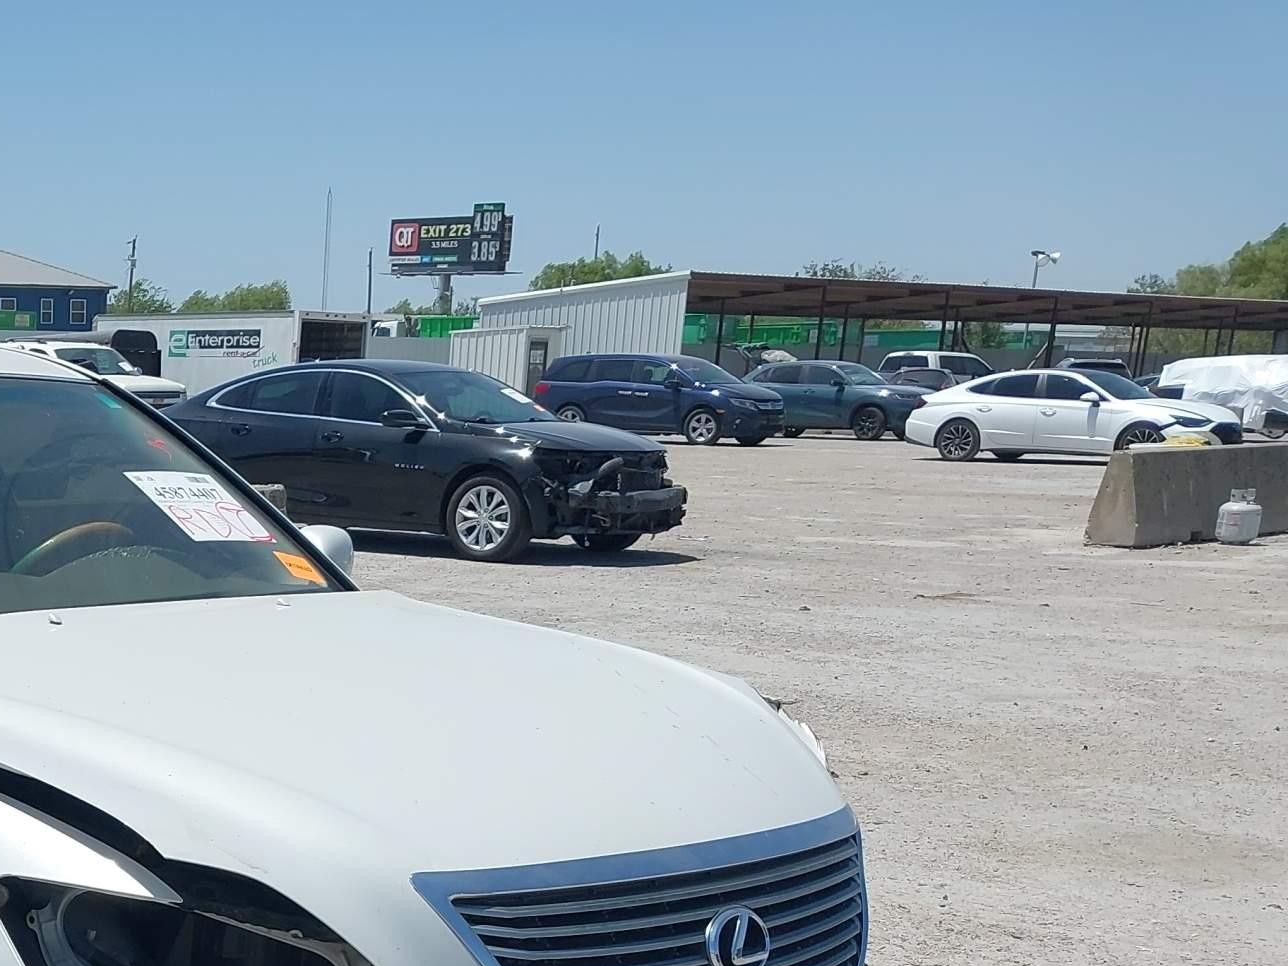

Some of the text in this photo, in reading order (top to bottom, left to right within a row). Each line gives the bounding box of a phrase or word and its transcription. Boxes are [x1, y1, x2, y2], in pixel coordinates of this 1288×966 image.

[395, 227, 414, 248] QT
[420, 224, 472, 238] EXIT 273
[441, 240, 458, 248] MILES
[188, 332, 260, 349] Enterprise
[253, 351, 278, 368] truck
